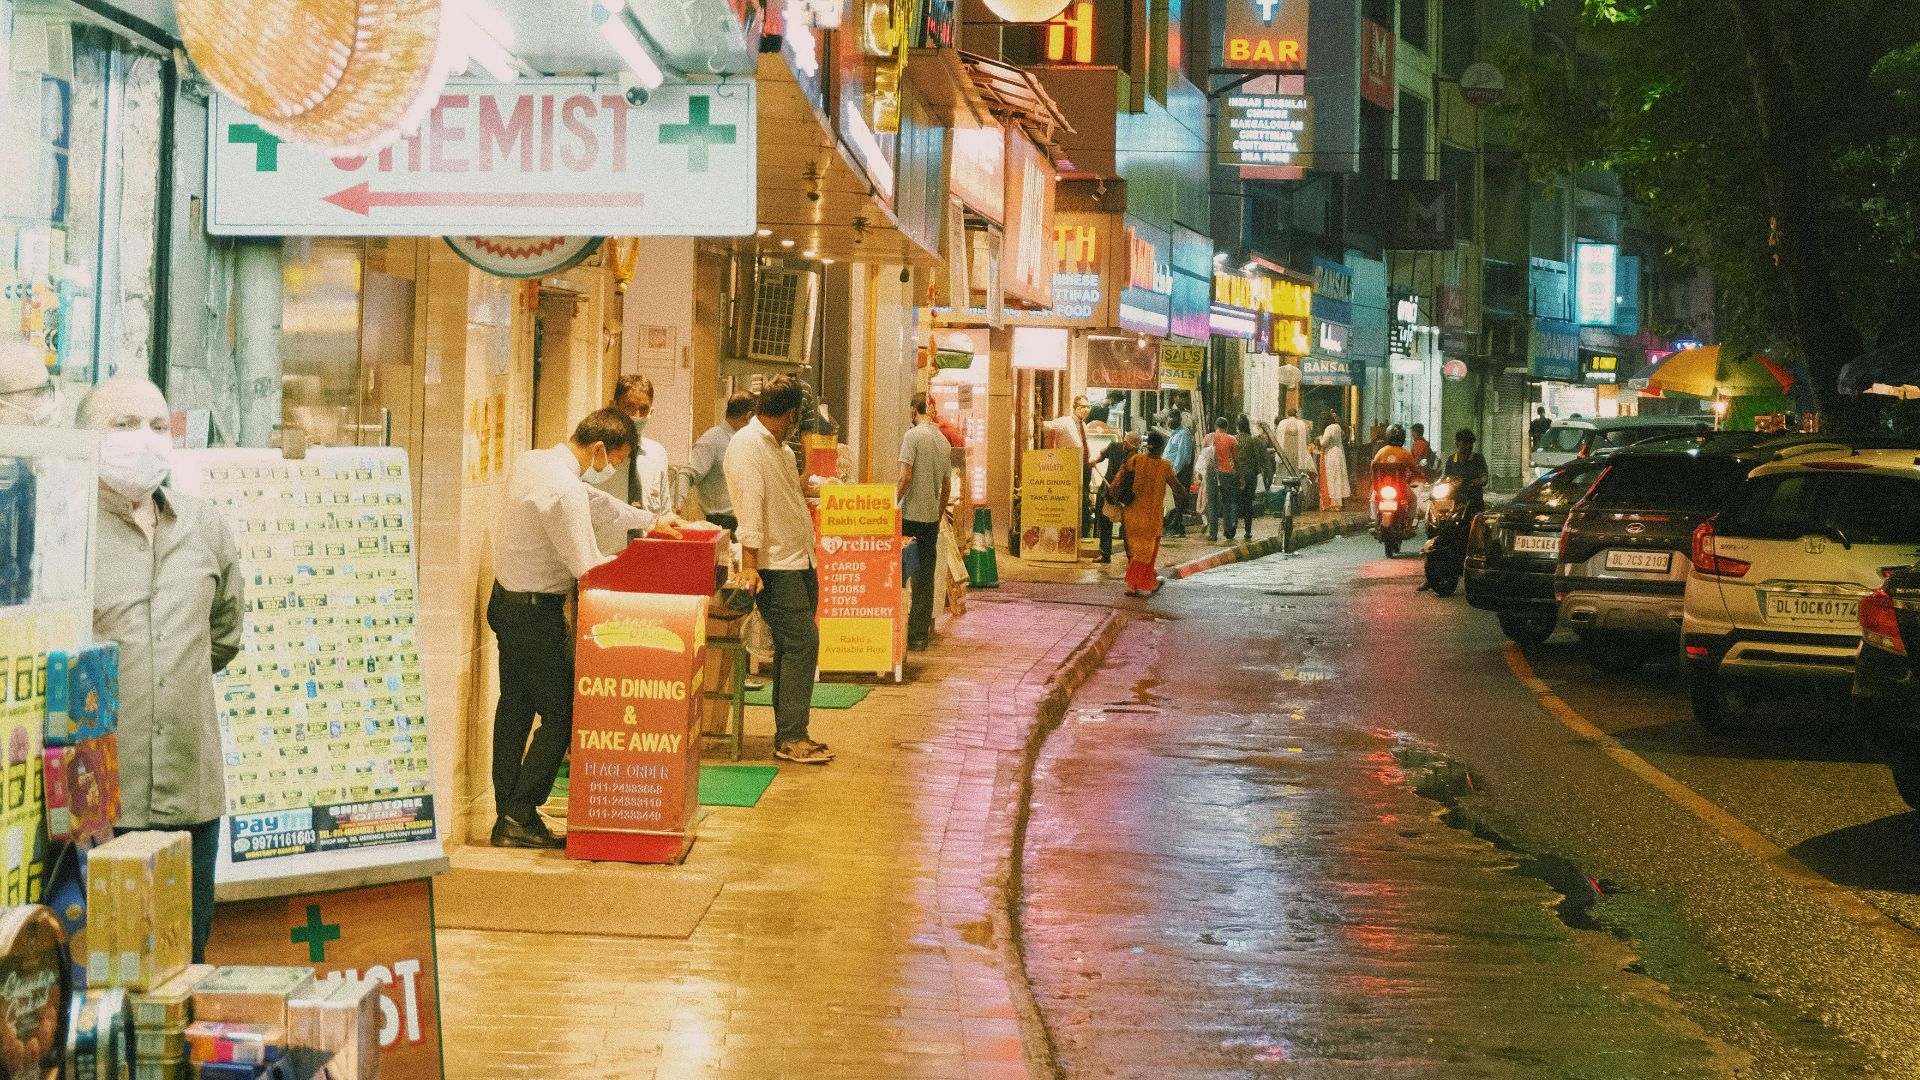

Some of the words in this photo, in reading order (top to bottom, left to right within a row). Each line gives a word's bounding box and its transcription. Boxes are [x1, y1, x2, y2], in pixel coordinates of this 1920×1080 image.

[1230, 38, 1300, 62] BAR
[329, 93, 634, 173] EMIST
[1056, 304, 1093, 318] FOOD
[826, 494, 892, 510] Archies
[828, 516, 855, 526] Rakhi
[858, 516, 889, 525] Cards
[832, 562, 867, 571] CARDS
[1612, 554, 1623, 565] DL
[832, 573, 861, 582] GIFTS
[832, 585, 866, 593] BOOKS
[832, 597, 858, 605] TOYS
[1777, 600, 1857, 616] DL10CK0174
[832, 607, 894, 616] STATIONERY
[578, 676, 617, 698] CAR
[620, 678, 686, 700] DINING
[624, 705, 638, 725] &
[577, 729, 626, 751] TAKE
[628, 732, 682, 754] AWAY
[585, 762, 622, 778] PLACE
[626, 763, 669, 780] ORDER
